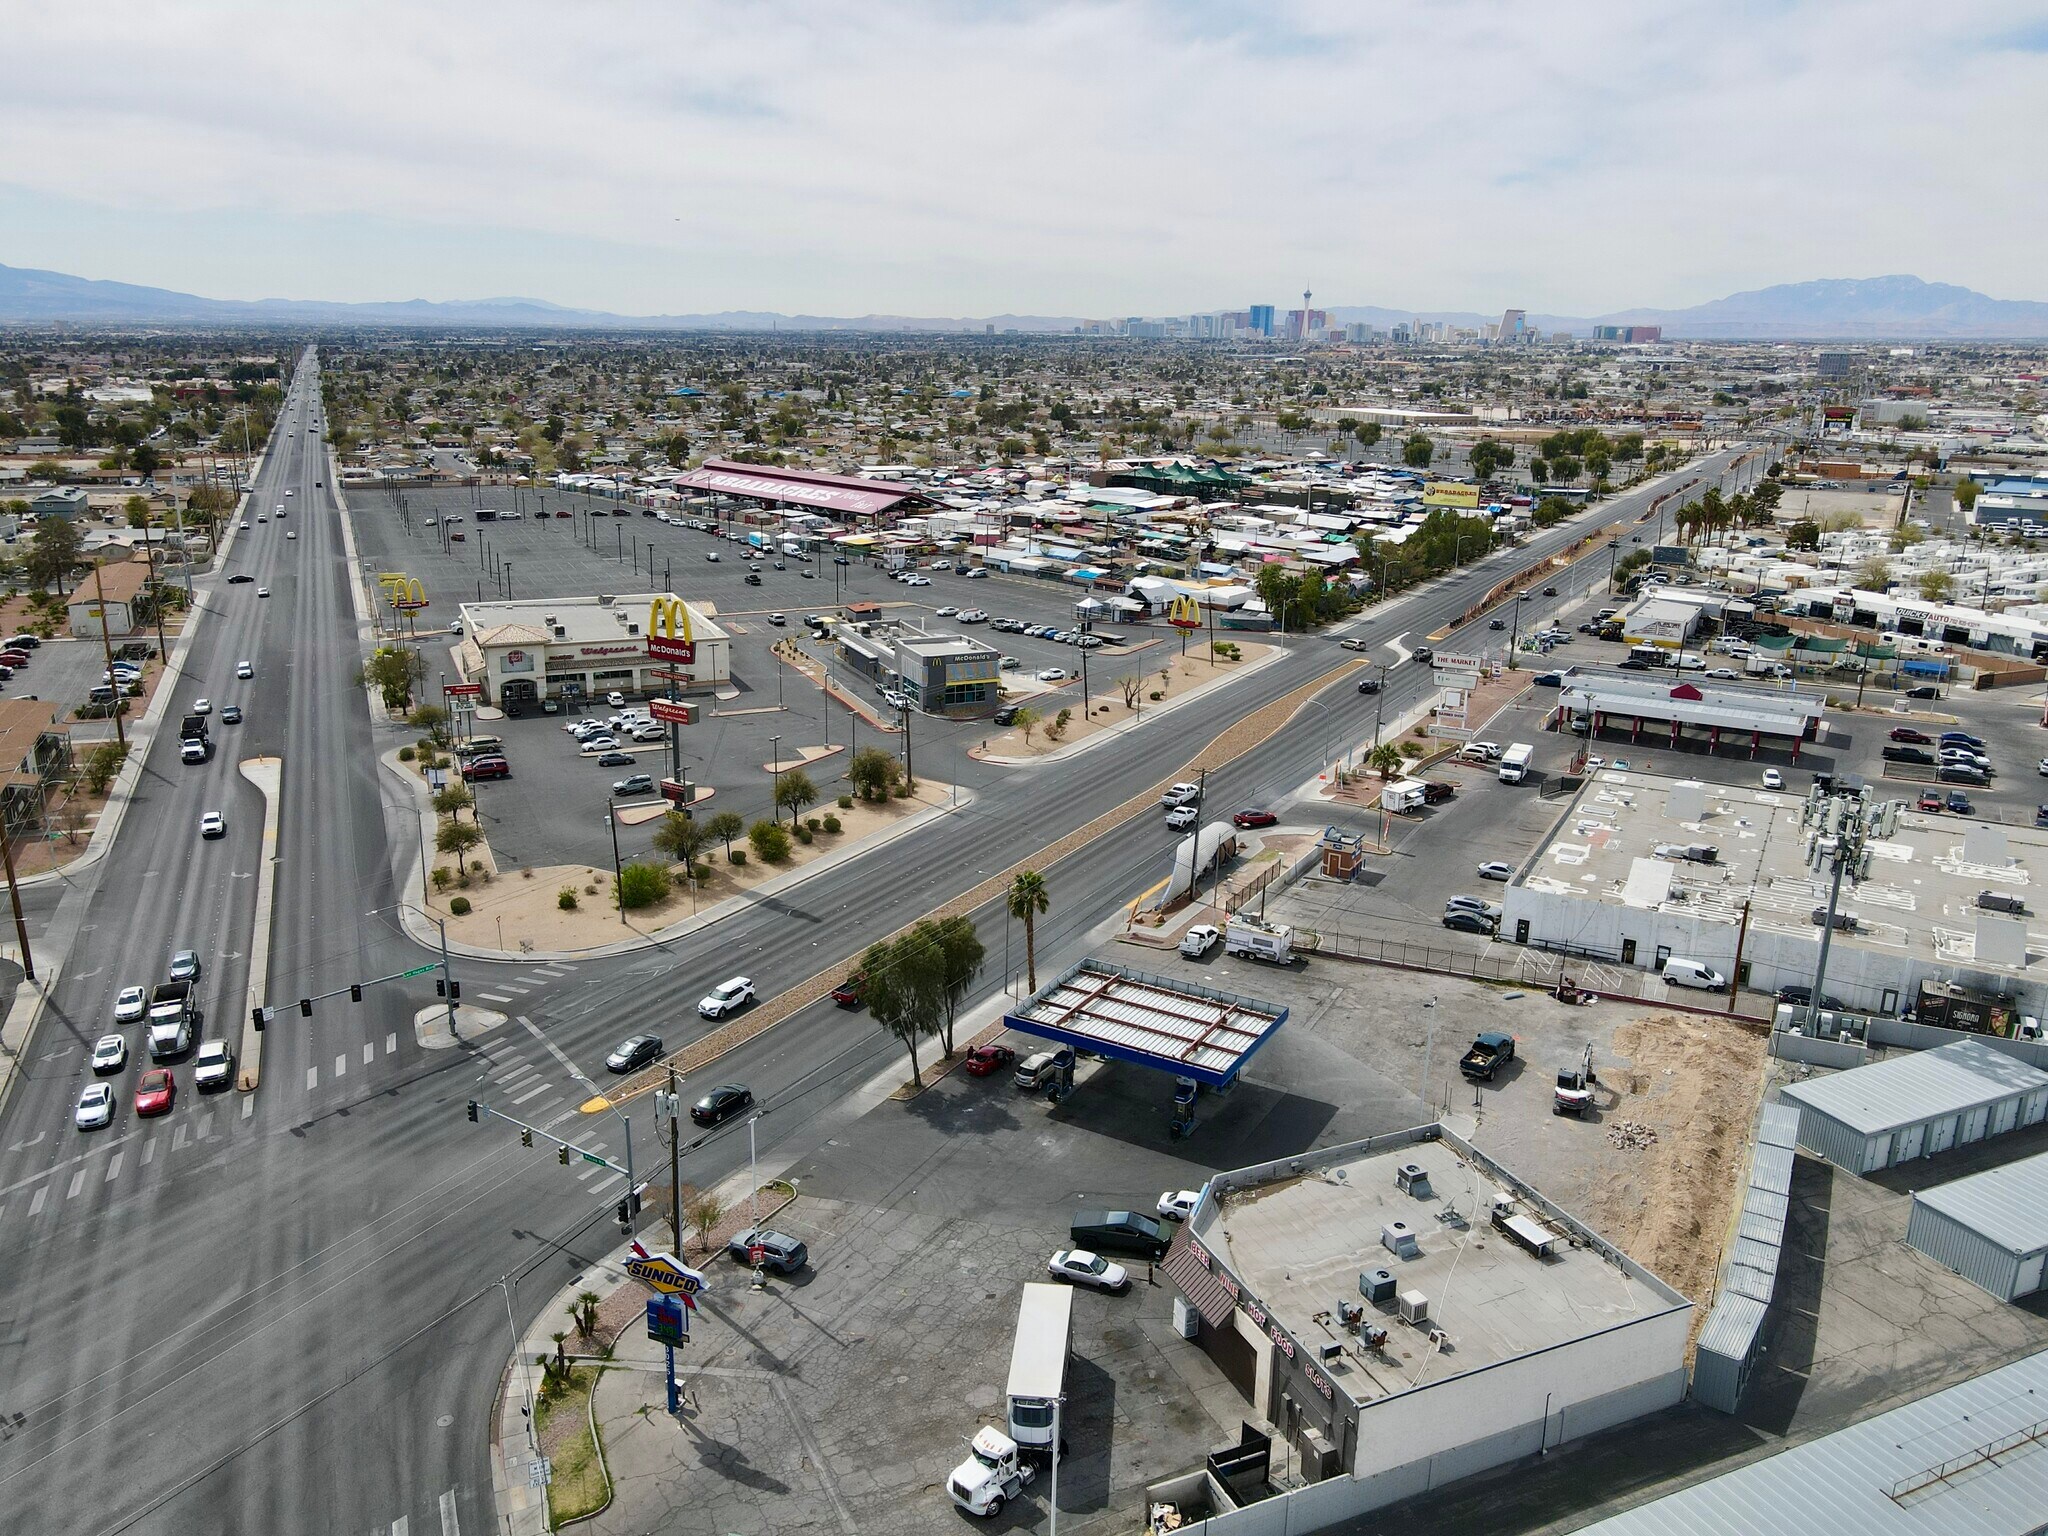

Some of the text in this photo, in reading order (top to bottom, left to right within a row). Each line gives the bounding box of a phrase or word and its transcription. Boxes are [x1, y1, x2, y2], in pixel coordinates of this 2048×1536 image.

[706, 475, 840, 501] BROADACRES
[1896, 608, 1928, 619] QUICKS
[1928, 613, 1950, 623] AUTO
[580, 645, 639, 656] Walgreens
[650, 644, 691, 658] McDonald's
[954, 654, 990, 662] McDonald's
[1451, 658, 1476, 666] MARKET
[651, 703, 688, 716] Walgreens
[1952, 1010, 1980, 1023] SIGNORA
[1190, 1239, 1211, 1270] BEER
[630, 1261, 697, 1292] SUNOCO
[1219, 1270, 1240, 1301] WINE
[1248, 1300, 1267, 1328] HOT
[1270, 1325, 1294, 1358] FOOD
[1305, 1362, 1332, 1400] SLOTS
